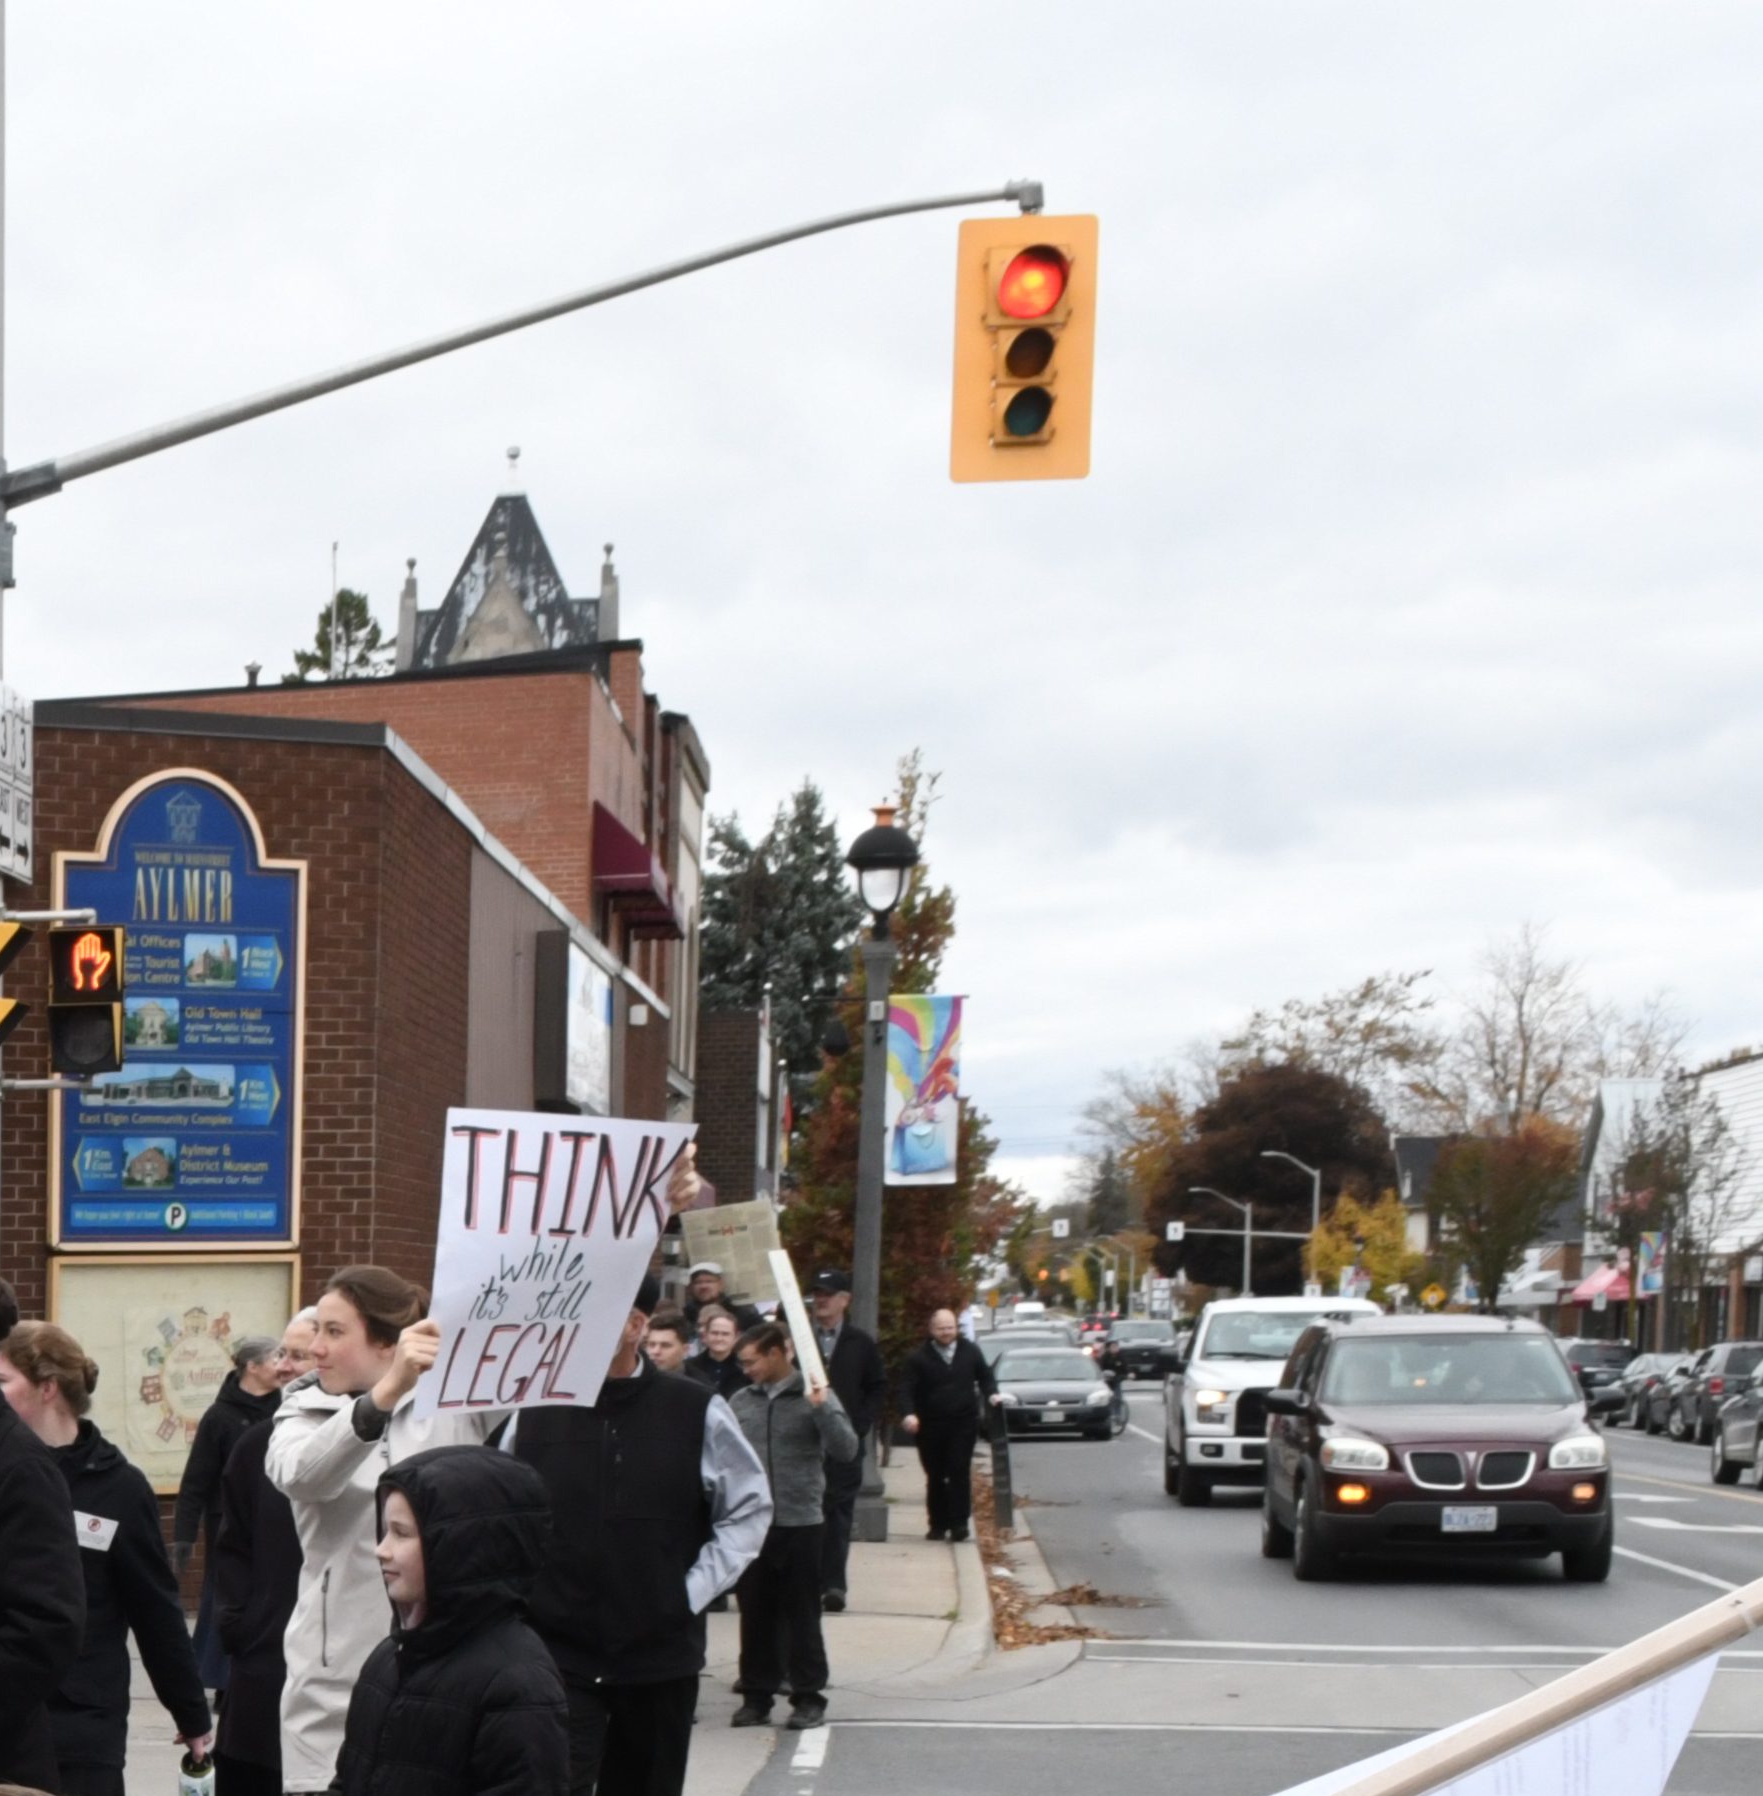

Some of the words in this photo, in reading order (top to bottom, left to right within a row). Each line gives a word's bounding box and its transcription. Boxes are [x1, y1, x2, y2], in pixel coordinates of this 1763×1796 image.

[133, 867, 233, 923] AYLMER
[142, 934, 180, 948] Offices
[145, 956, 180, 969] Tourist
[145, 972, 180, 984] Centre
[185, 1007, 205, 1020] Old
[208, 1008, 237, 1020] Town
[241, 1009, 262, 1021] Hall
[185, 1023, 212, 1034] Aylmer
[216, 1023, 240, 1034] Public
[241, 1024, 271, 1035] Library
[185, 1034, 203, 1044] Old
[205, 1035, 223, 1044] Town
[242, 1036, 275, 1046] Theatre
[79, 1113, 101, 1124] East
[104, 1113, 129, 1126] Elgin
[132, 1113, 189, 1127] Community
[191, 1114, 234, 1127] Complex
[180, 1143, 219, 1157] Aylmer
[221, 1144, 232, 1156] &
[179, 1160, 220, 1172] District
[223, 1160, 269, 1173] Museum
[180, 1174, 224, 1186] Experience
[225, 1176, 240, 1186] Our
[241, 1175, 264, 1186] Past!
[451, 1125, 690, 1240] THINK
[500, 1235, 585, 1283] while
[468, 1276, 510, 1322] it's
[524, 1280, 592, 1322] still
[438, 1321, 581, 1408] LEGAL
